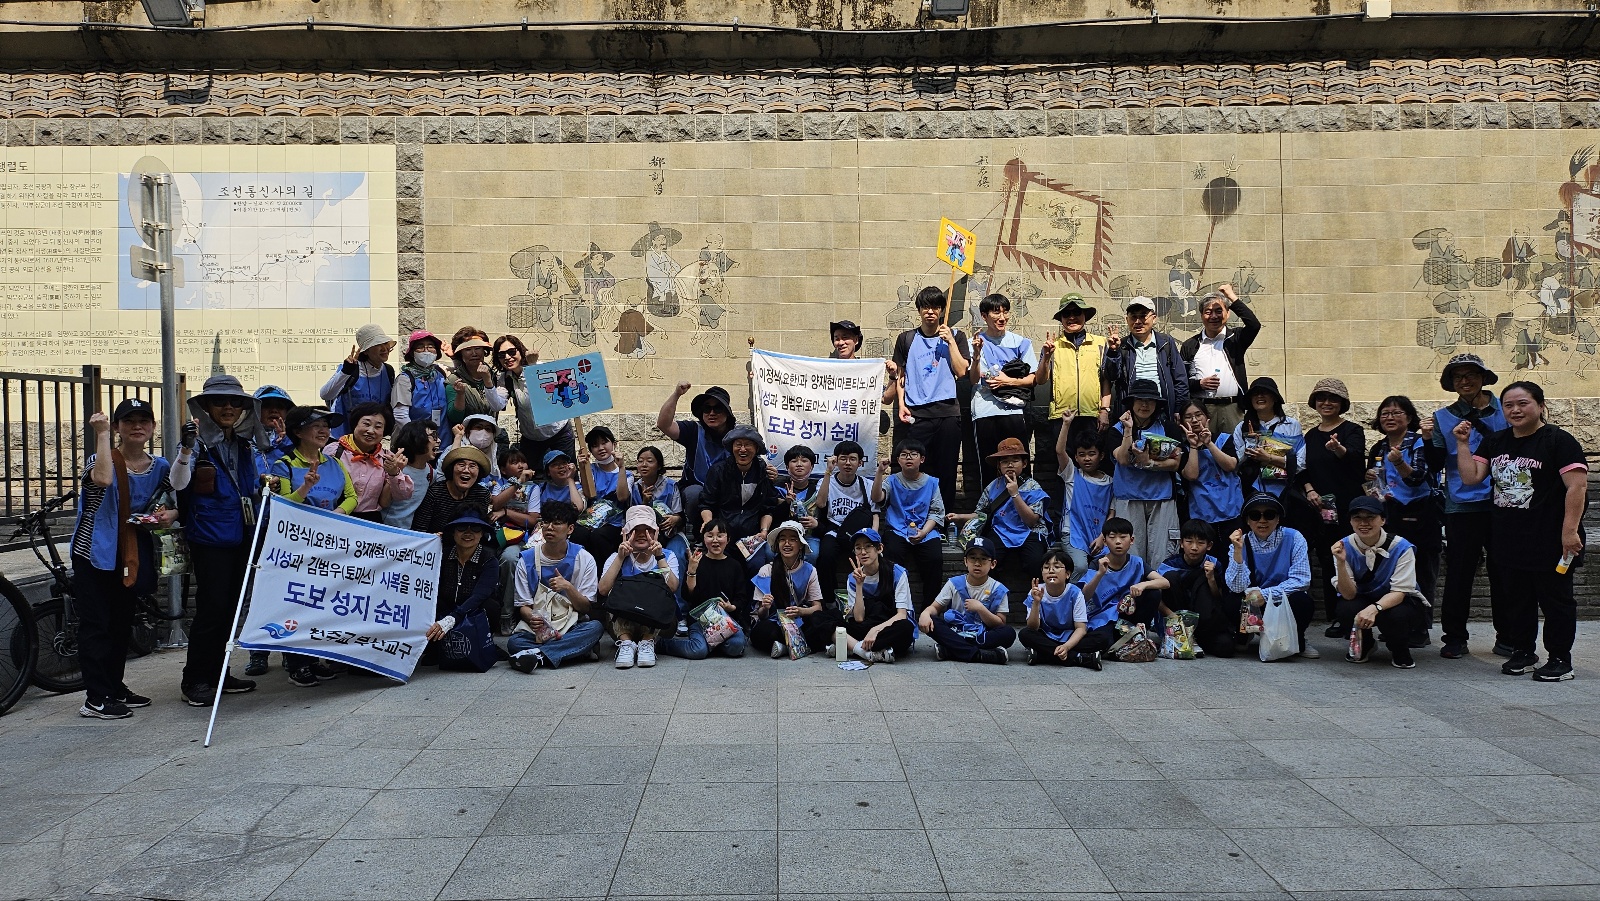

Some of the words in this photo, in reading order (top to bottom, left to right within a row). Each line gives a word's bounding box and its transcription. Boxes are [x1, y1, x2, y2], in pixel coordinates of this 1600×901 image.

[218, 185, 297, 198] 조선통신사의
[302, 185, 313, 198] 길
[760, 367, 808, 388] 이정식(요한)과
[811, 374, 877, 390] 양재현(마르티노)의
[761, 390, 778, 408] 성과
[781, 394, 829, 414] 김범우(토마스)
[833, 399, 857, 415] 시복을
[861, 399, 877, 415] 위한
[767, 415, 796, 437] 도보
[799, 420, 827, 441] 성지
[830, 421, 859, 442] 순례
[277, 519, 351, 554] 이정식(요한)과
[353, 540, 436, 571] 양재현(마르티노)의
[266, 546, 305, 572] 시성과
[307, 555, 376, 586] 김범우(토마스)
[379, 571, 411, 595] 시복을
[413, 577, 434, 601] 위한
[283, 581, 327, 611] 도보
[330, 590, 371, 622] 성지
[373, 599, 411, 630] 순례
